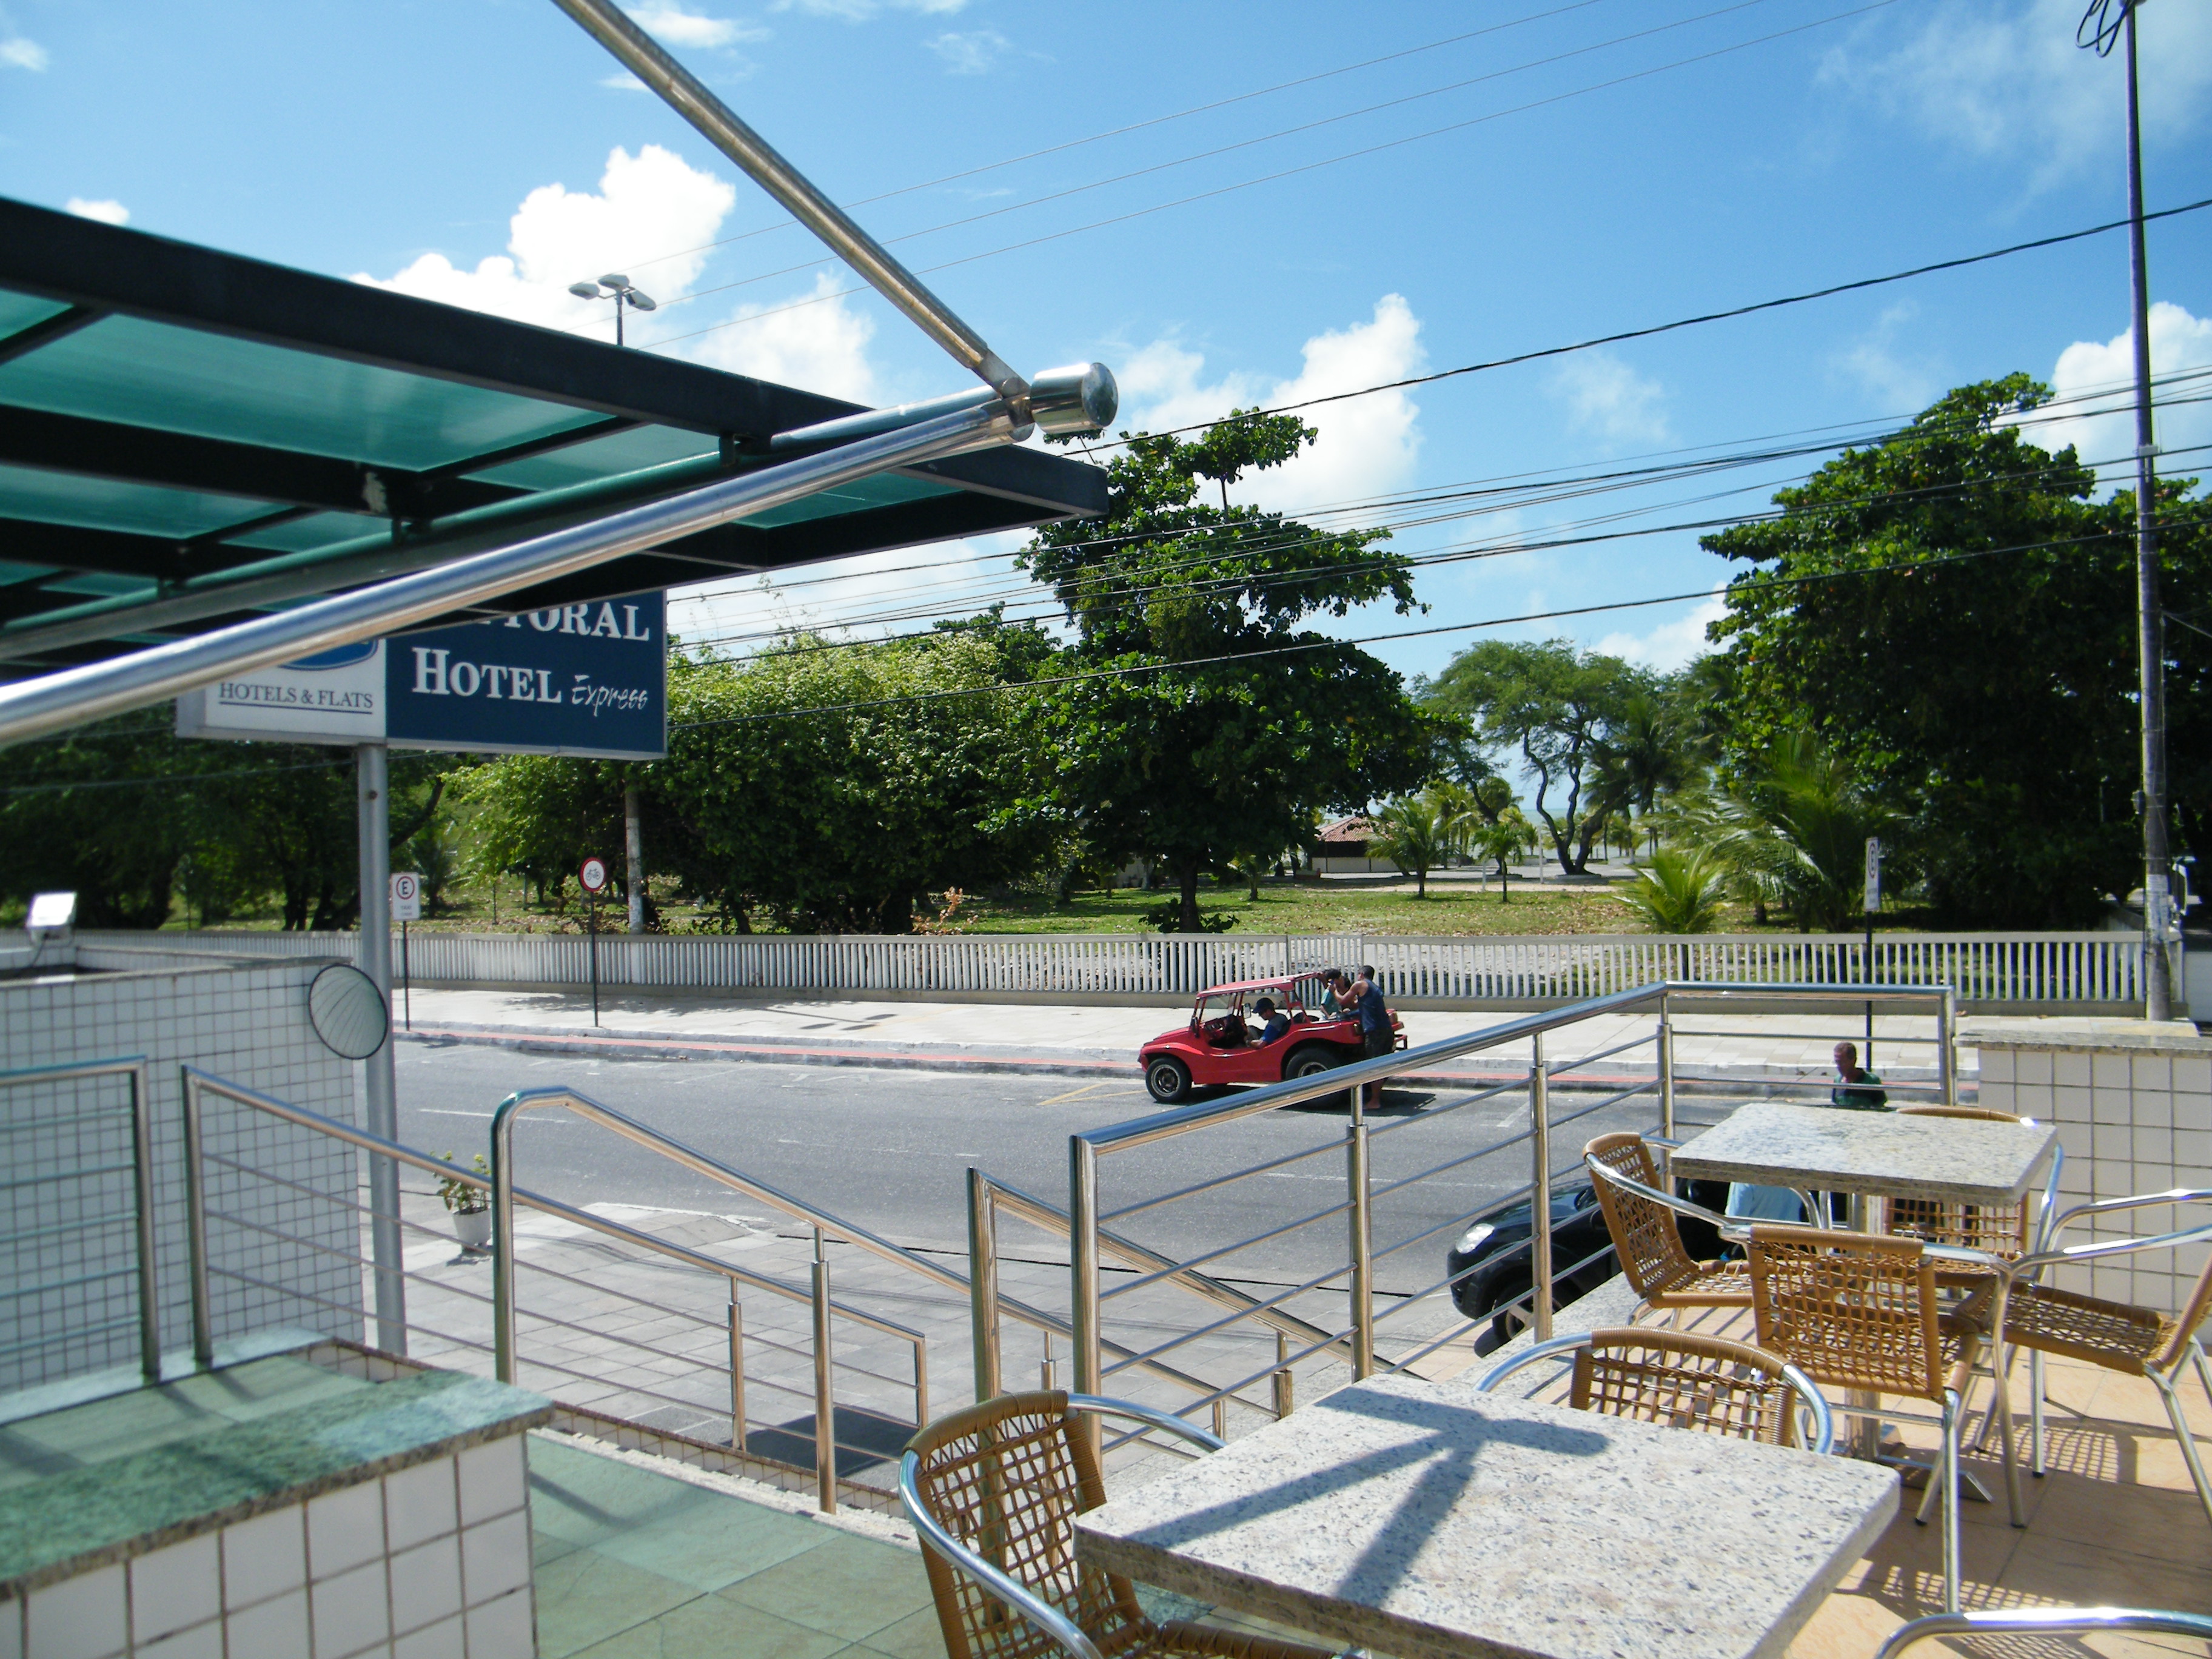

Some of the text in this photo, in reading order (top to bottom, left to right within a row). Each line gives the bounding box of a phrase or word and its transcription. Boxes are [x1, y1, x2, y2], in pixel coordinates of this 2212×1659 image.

[412, 646, 648, 717] HOTEL Express
[220, 682, 374, 709] HOTELS & FLATS
[402, 881, 409, 895] E
